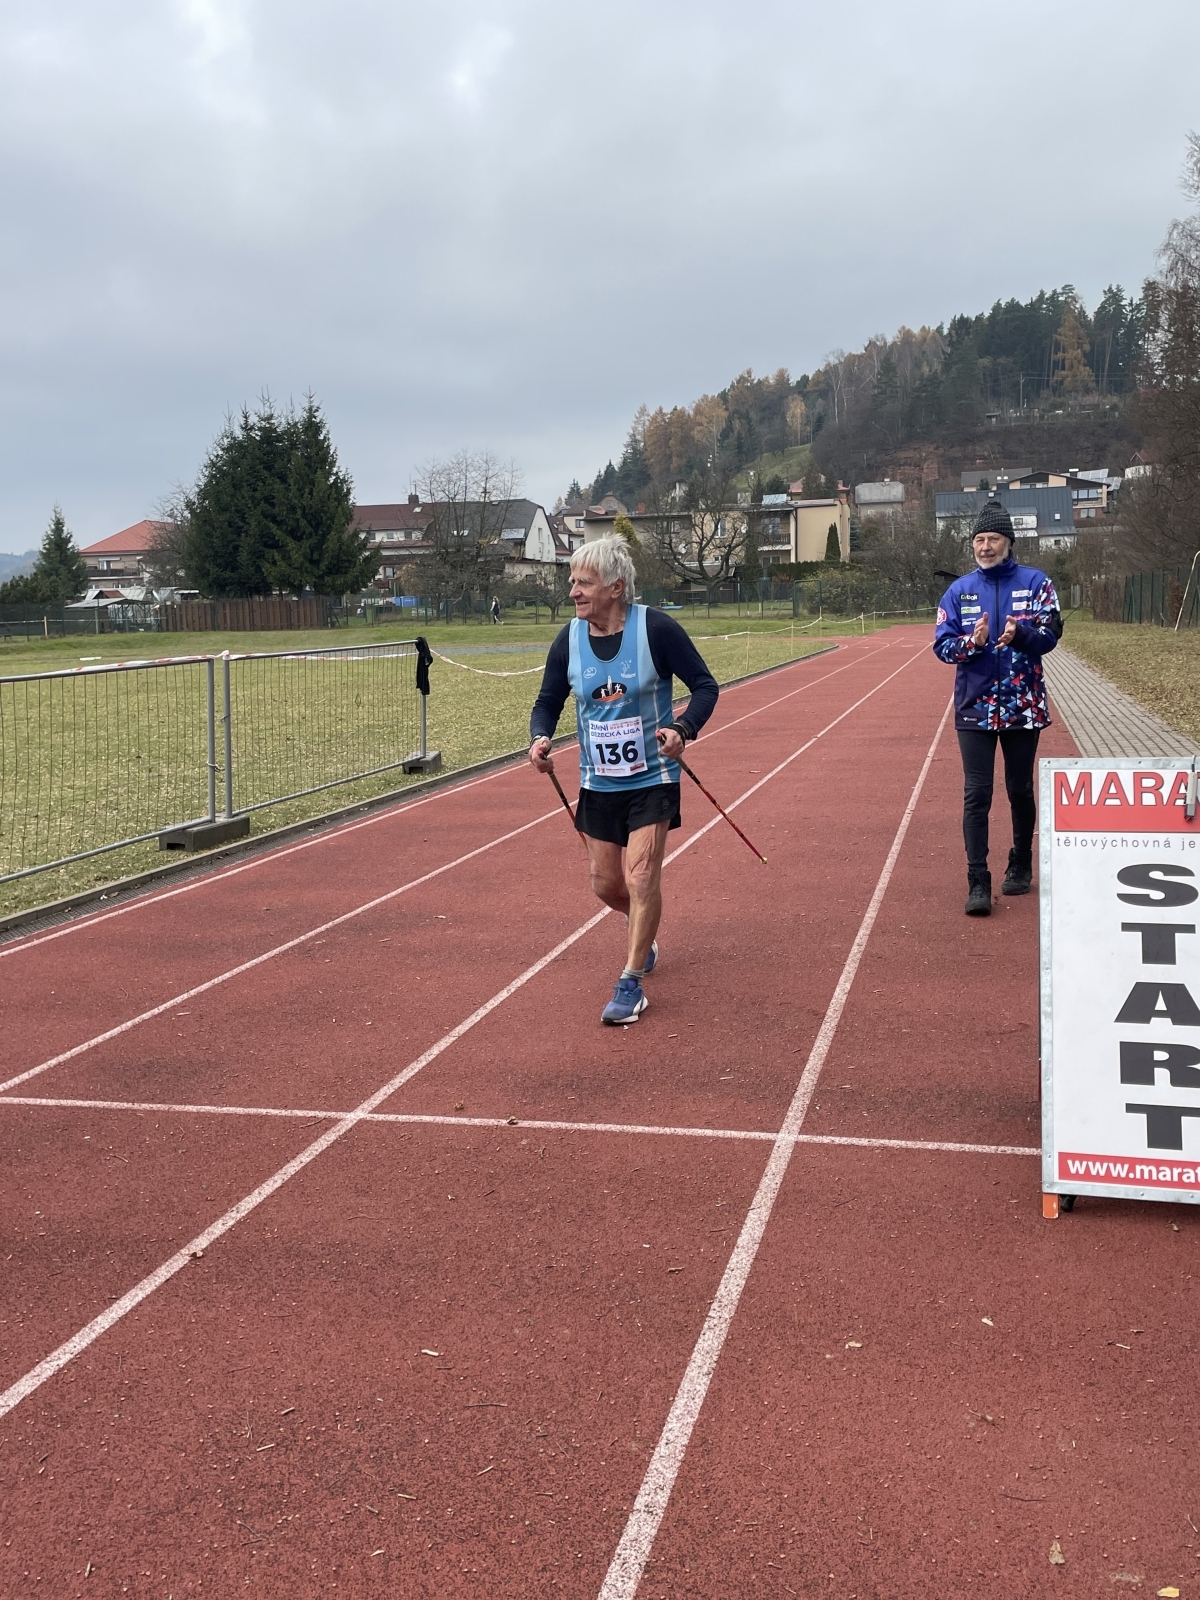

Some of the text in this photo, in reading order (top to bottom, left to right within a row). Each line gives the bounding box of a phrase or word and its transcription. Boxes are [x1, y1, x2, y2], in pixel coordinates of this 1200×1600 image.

[595, 740, 638, 765] 136
[1054, 771, 1200, 806] MARA
[1057, 837, 1200, 851] tělovýchovná je
